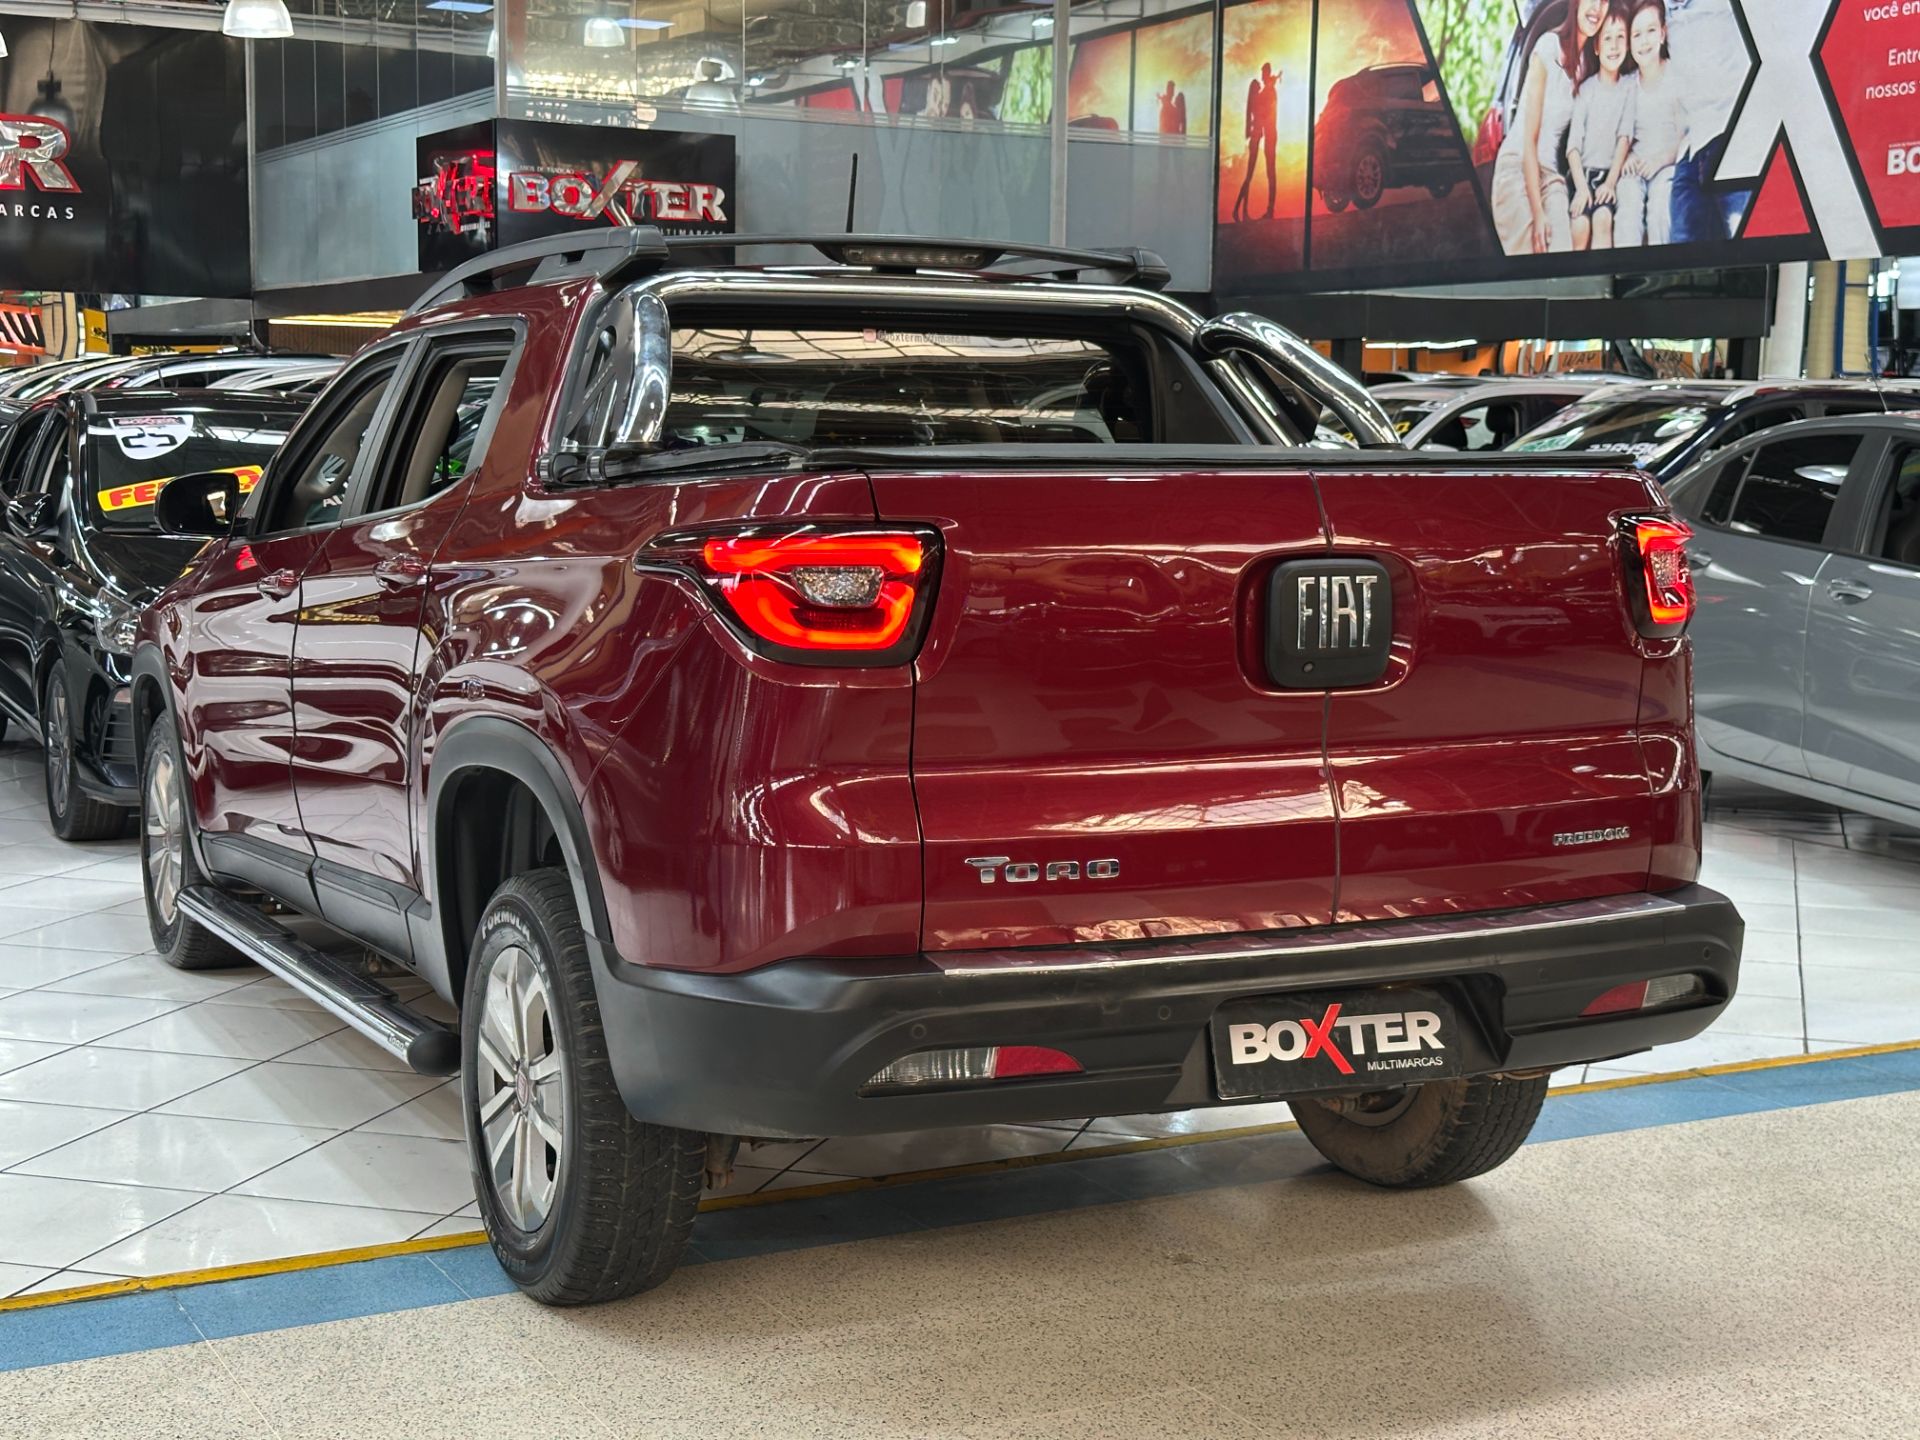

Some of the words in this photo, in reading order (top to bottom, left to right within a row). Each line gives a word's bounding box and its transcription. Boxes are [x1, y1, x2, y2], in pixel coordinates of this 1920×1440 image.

[1864, 0, 1899, 21] você
[1865, 80, 1916, 100] nossos
[508, 159, 728, 227] BOXTER
[1297, 575, 1378, 650] FIAT
[1553, 826, 1630, 847] FREEDOM
[964, 856, 1120, 884] TORO
[1229, 1003, 1445, 1075] BOXTER
[1367, 1056, 1443, 1071] MULTIMARCAS
